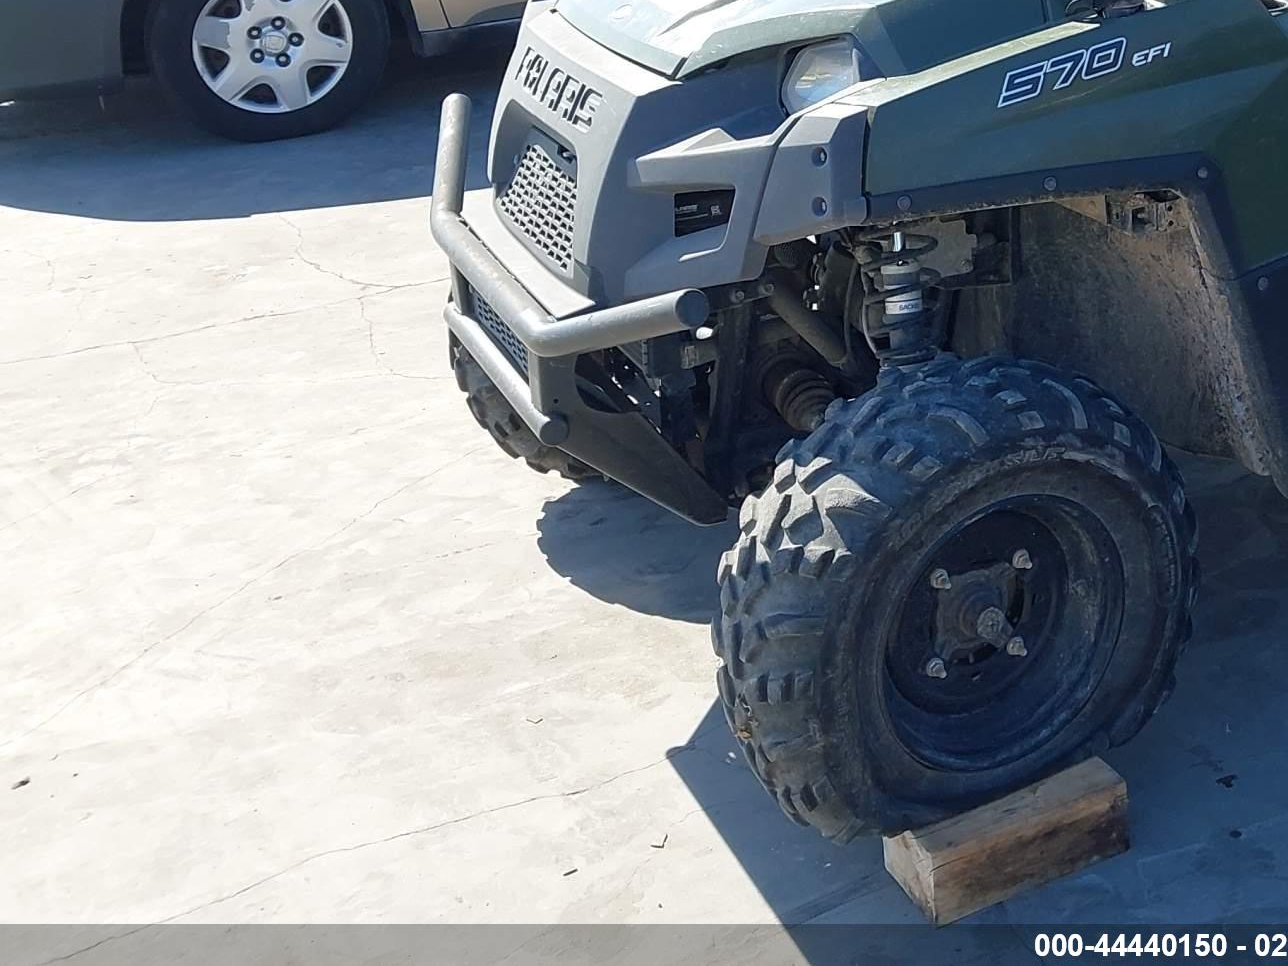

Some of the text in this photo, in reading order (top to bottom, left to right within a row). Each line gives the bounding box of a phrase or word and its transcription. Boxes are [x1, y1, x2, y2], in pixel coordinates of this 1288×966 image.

[514, 45, 603, 128] POLARIS
[997, 37, 1172, 108] 570 EFI
